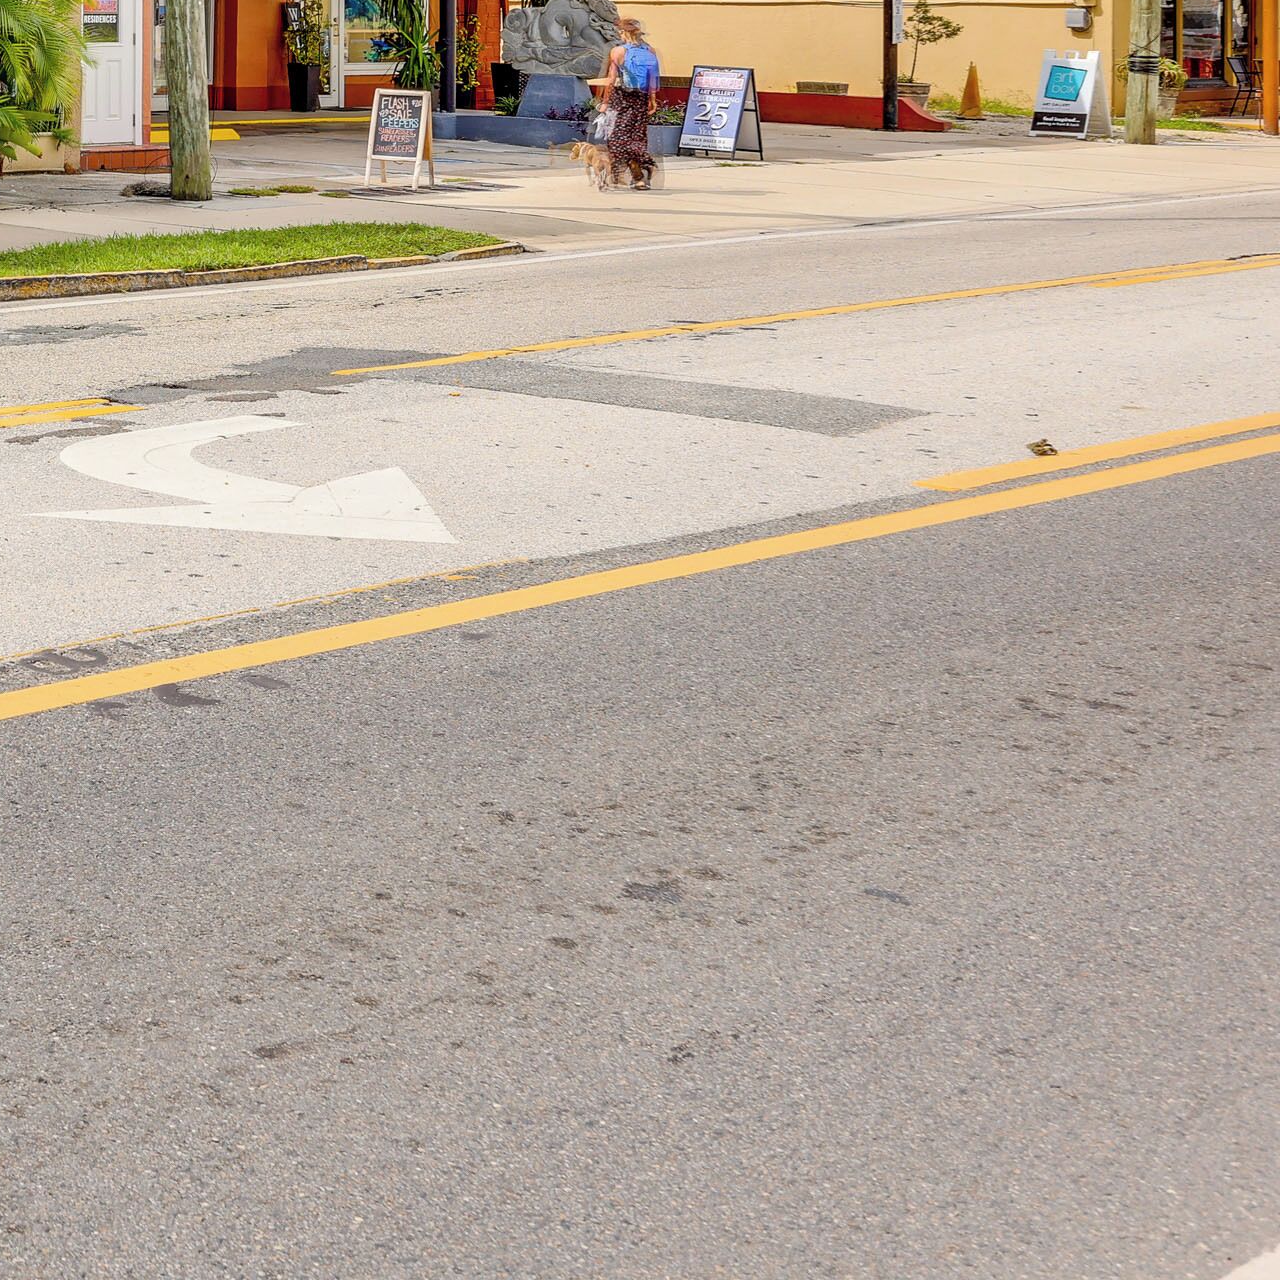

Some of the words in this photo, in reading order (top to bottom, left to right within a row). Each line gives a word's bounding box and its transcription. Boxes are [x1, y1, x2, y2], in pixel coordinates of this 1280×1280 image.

[83, 14, 117, 24] RESIDENCES
[1054, 71, 1073, 83] art
[1051, 83, 1075, 94] box
[381, 96, 409, 110] FLASH
[692, 94, 740, 104] CELEBRATING
[389, 109, 413, 119] SALE
[694, 101, 731, 131] 25
[381, 118, 419, 129] PEEPERS
